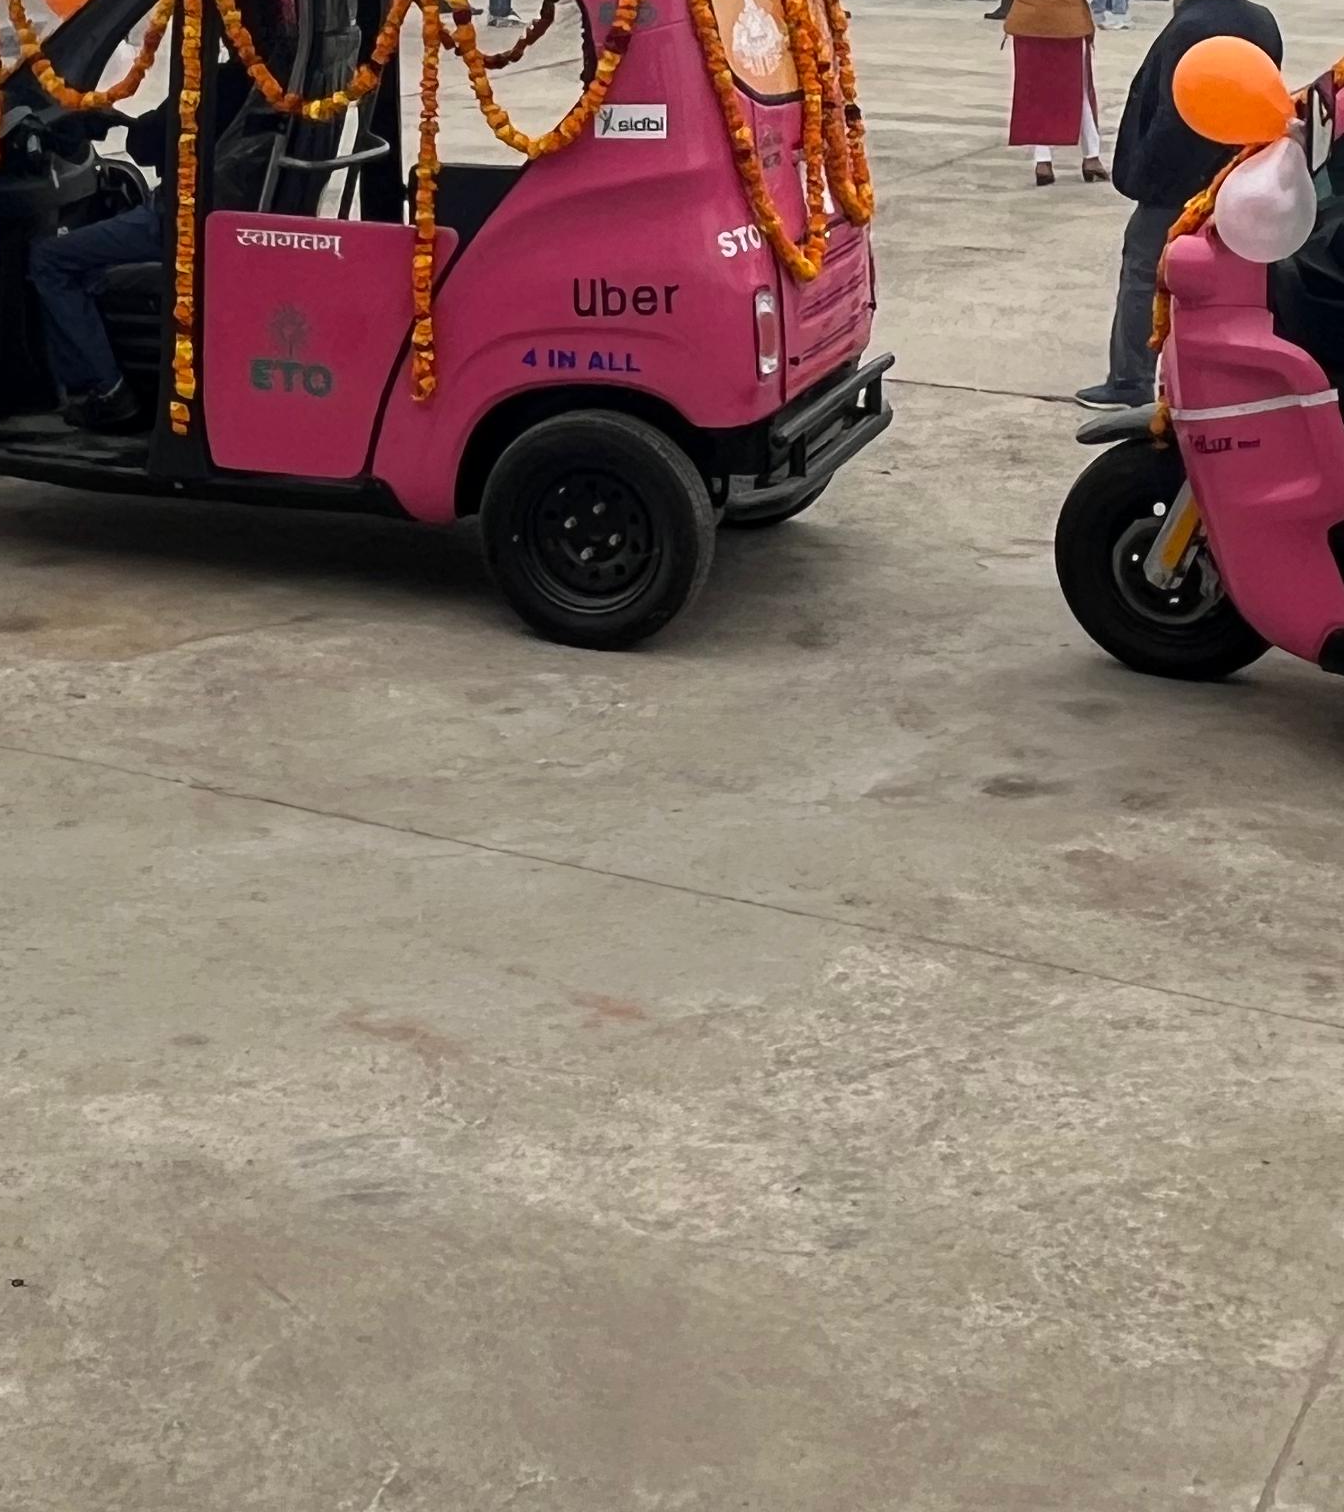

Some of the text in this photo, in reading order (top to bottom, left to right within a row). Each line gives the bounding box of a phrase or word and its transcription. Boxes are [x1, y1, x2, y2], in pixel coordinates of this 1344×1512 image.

[236, 229, 344, 259] स्वागतम्
[717, 224, 762, 258] STO
[573, 277, 680, 317] Uber
[522, 348, 642, 372] 4 IN ALL
[251, 359, 333, 397] ETO
